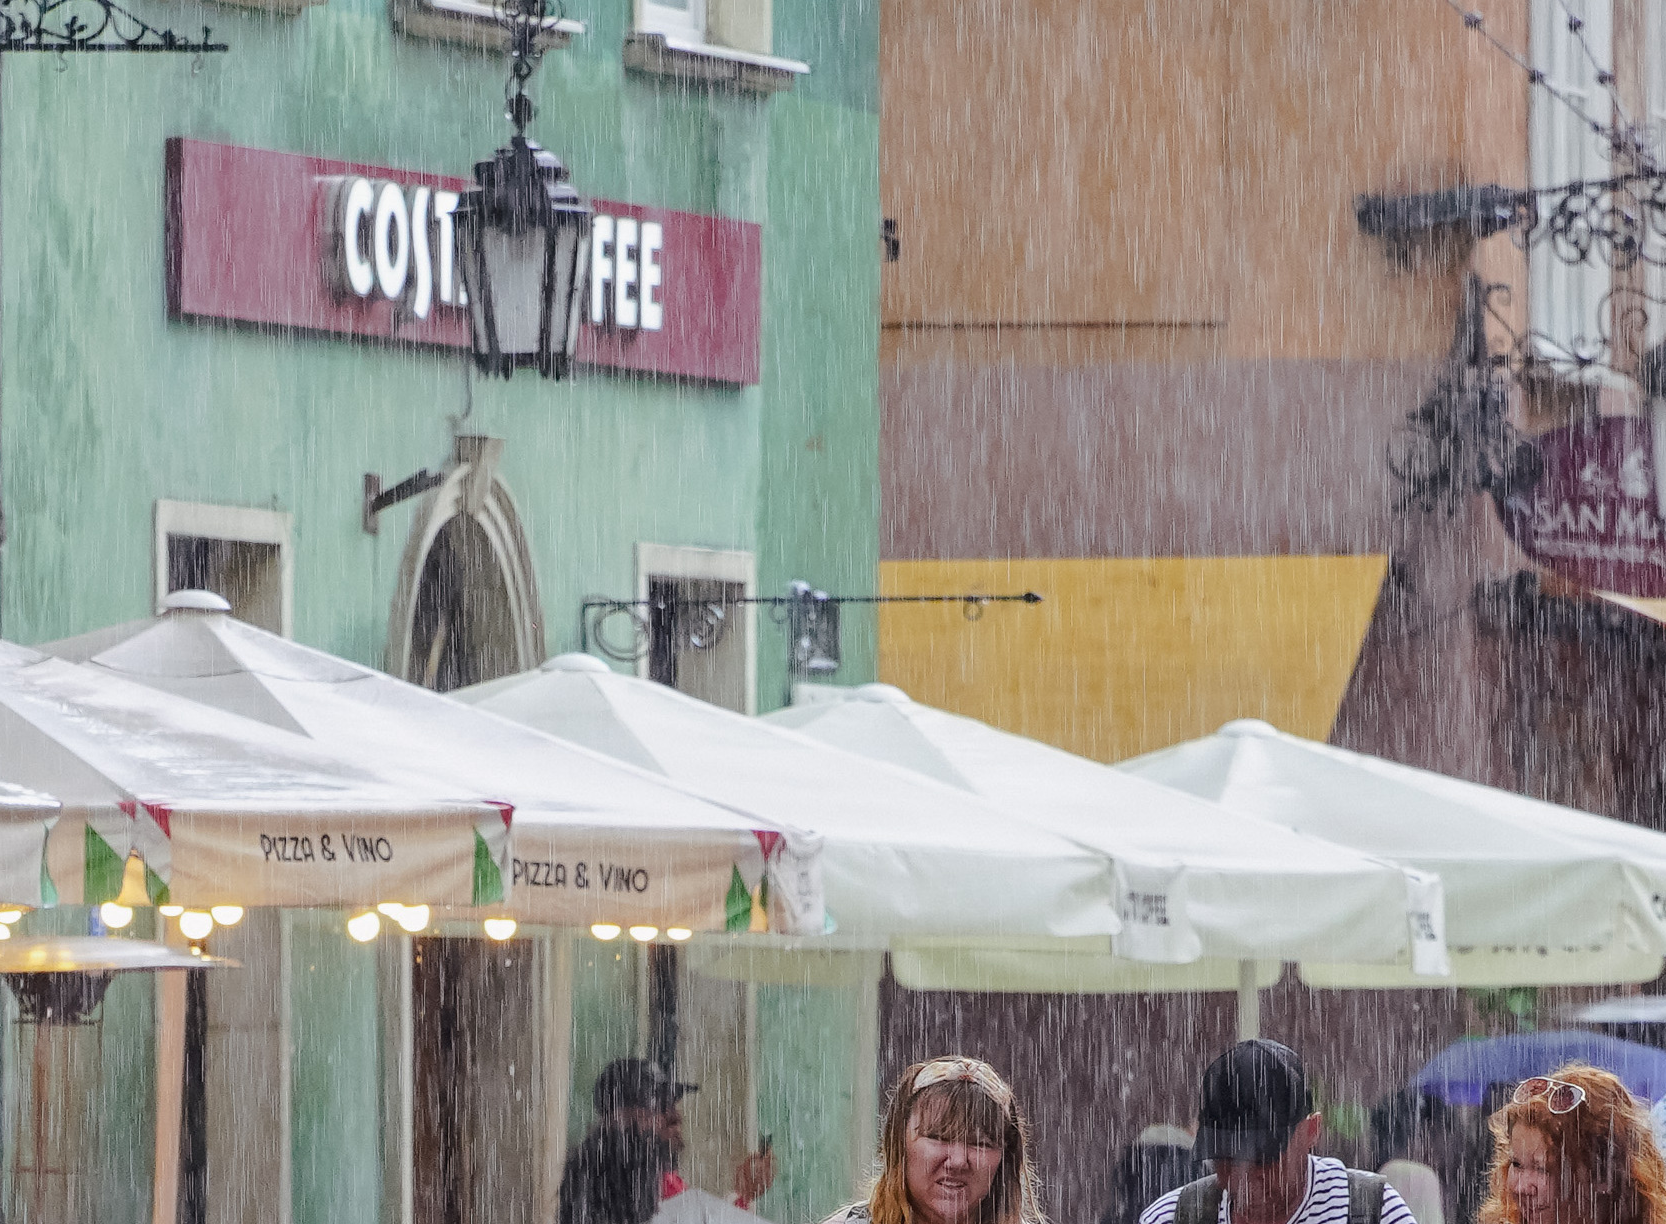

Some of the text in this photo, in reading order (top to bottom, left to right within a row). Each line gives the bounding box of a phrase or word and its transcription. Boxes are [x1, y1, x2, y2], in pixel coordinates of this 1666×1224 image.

[345, 176, 663, 331] COST FEE
[1534, 501, 1605, 533] SAN
[259, 833, 394, 863] PIZZA & VINO
[511, 857, 651, 893] PIZZA & VINO
